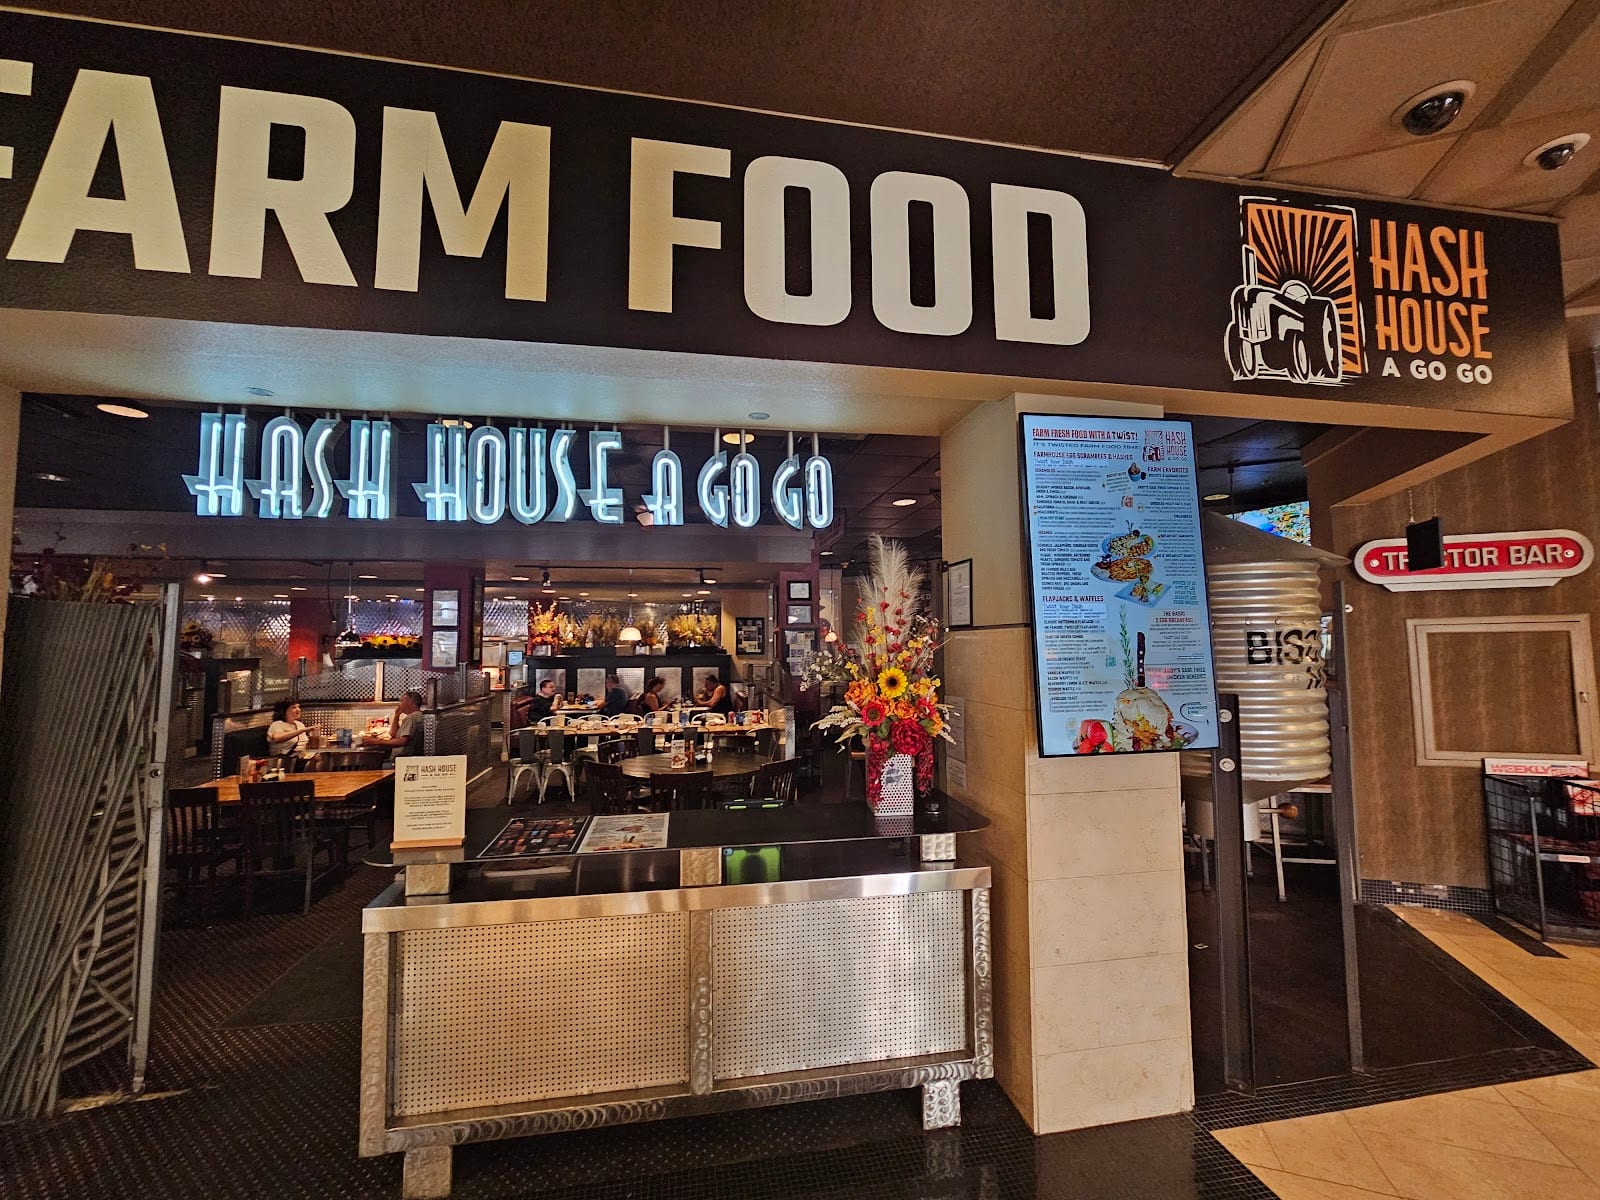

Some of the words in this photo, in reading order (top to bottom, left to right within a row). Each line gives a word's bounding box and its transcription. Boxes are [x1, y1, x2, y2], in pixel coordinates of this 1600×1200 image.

[628, 137, 1091, 345] FOOD
[1369, 218, 1488, 299] HASH
[1376, 294, 1492, 359] HOUSE
[1382, 357, 1401, 378] A
[1410, 359, 1447, 381] GO
[1456, 363, 1493, 385] GO
[1032, 428, 1050, 438] FARM
[1051, 429, 1071, 438] FRESH
[1071, 430, 1088, 439] FOOD
[1088, 430, 1106, 440] WITH
[1106, 431, 1111, 440] A
[1165, 430, 1186, 445] HASH
[1166, 445, 1187, 457] HOUSE
[182, 412, 392, 520] HASH
[411, 423, 624, 525] HOUSE
[641, 450, 684, 526] A
[1509, 543, 1564, 566] BAR
[1491, 764, 1551, 774] WEEKLY
